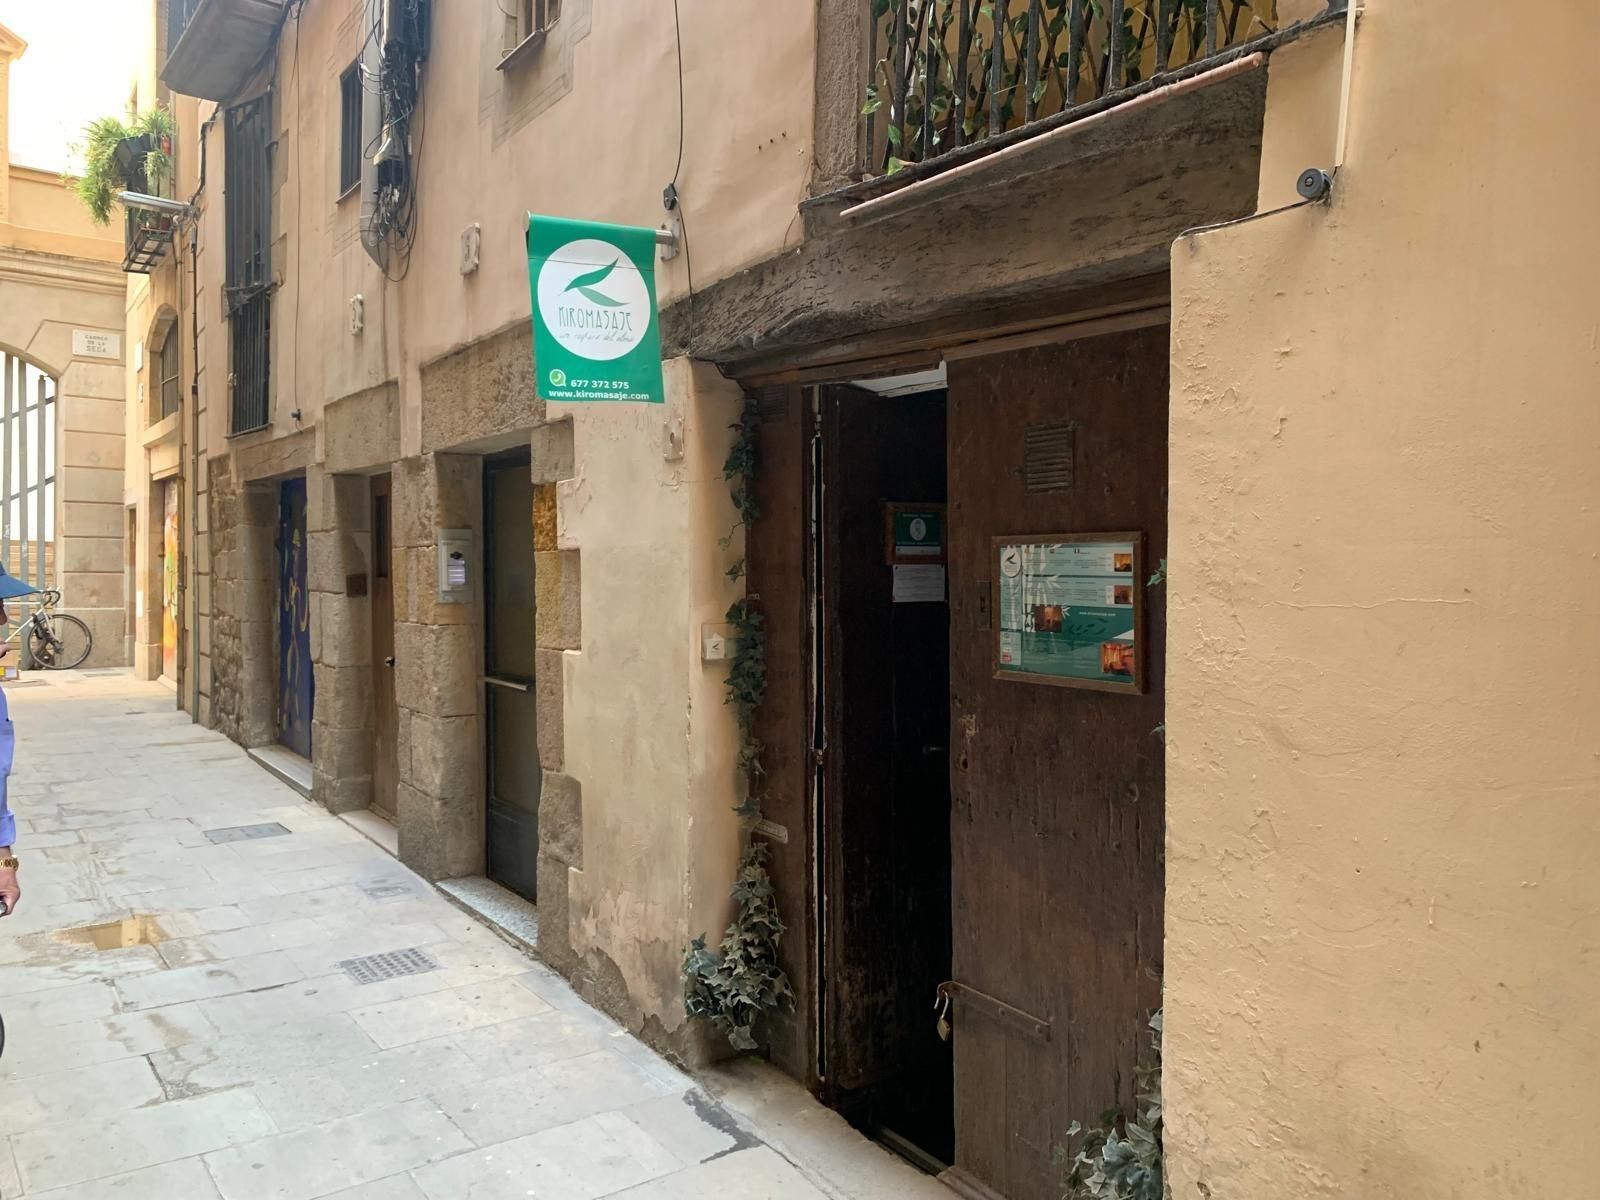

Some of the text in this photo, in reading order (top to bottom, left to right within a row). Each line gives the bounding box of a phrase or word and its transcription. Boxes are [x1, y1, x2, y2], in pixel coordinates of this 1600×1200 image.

[559, 307, 633, 331] KIROMASAJE
[570, 380, 630, 390] 677 372 575
[548, 390, 649, 400] www.kiromasaje.com
